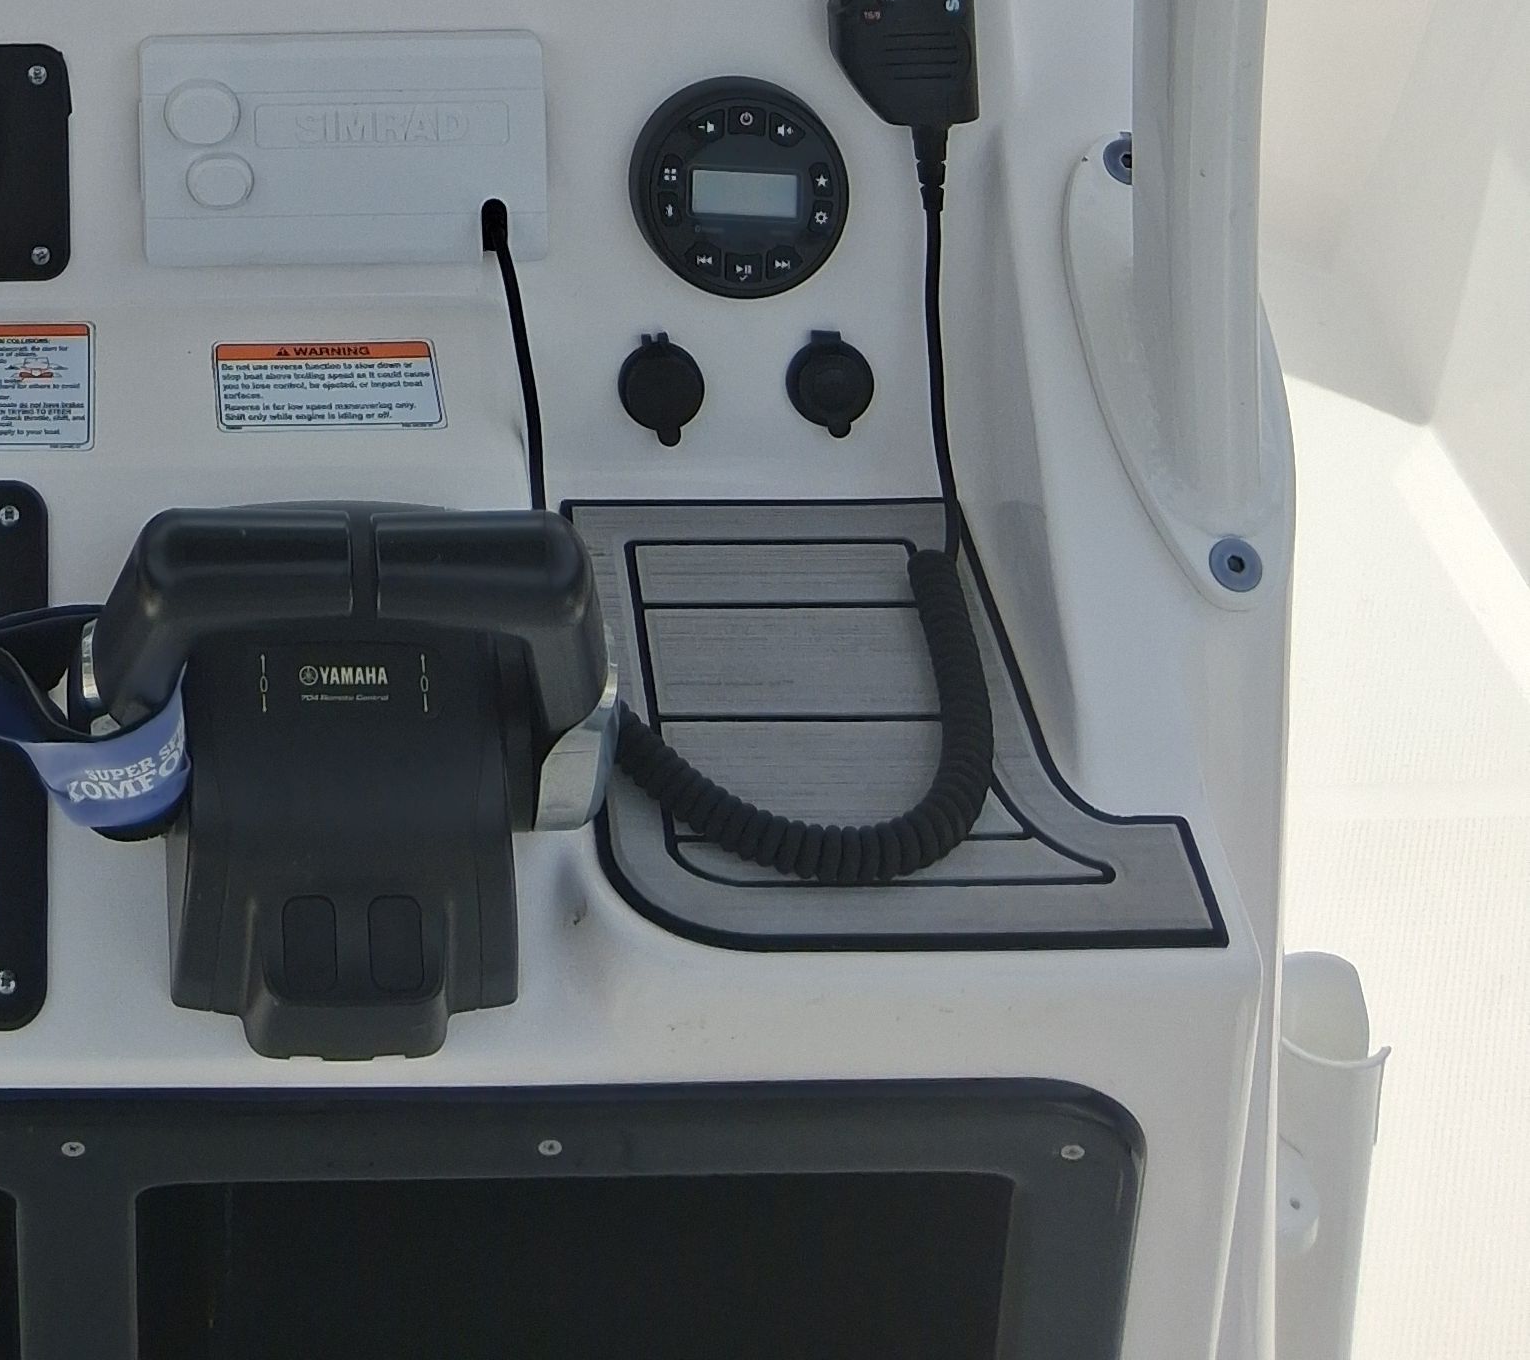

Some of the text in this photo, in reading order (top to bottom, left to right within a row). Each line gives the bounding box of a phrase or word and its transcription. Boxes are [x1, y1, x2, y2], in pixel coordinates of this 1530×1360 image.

[295, 105, 468, 143] SIMRAD
[293, 346, 370, 356] WARNING
[319, 666, 388, 685] YAMAHA
[84, 756, 156, 781] SUPER
